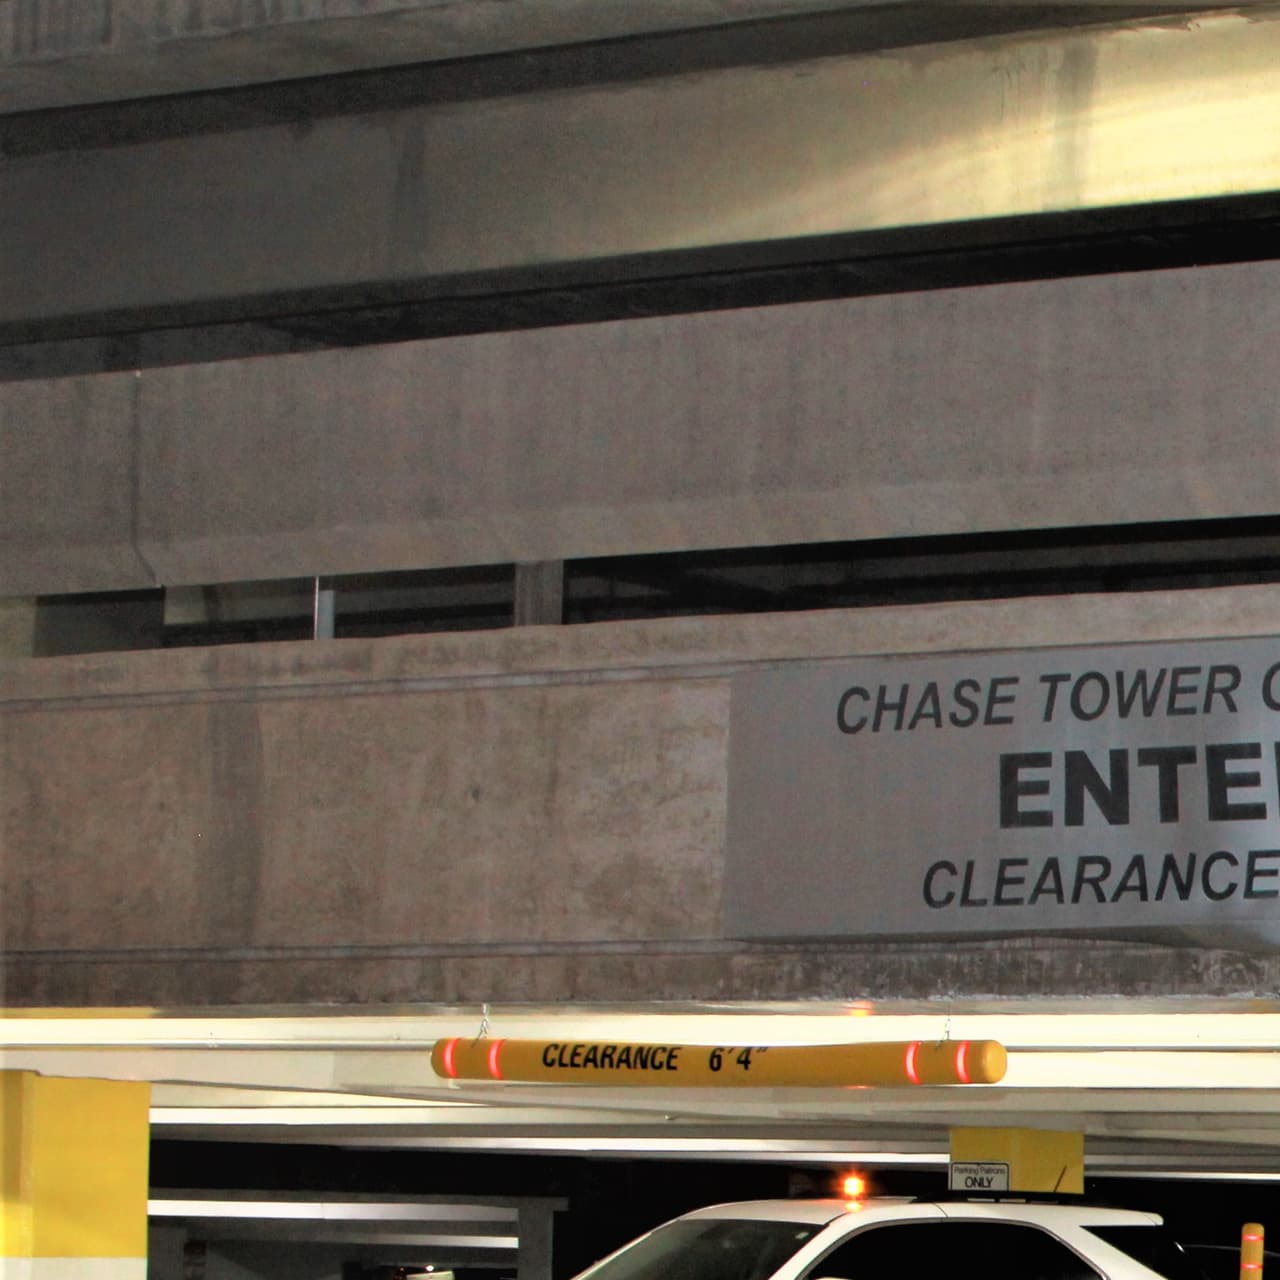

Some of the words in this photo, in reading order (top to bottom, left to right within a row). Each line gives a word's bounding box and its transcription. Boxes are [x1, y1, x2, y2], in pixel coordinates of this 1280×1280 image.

[836, 677, 1019, 735] CHASE
[1040, 664, 1241, 723] TOWER
[922, 849, 1280, 908] CLEARANCE
[542, 1044, 682, 1071] CLEARANCE
[964, 1176, 993, 1188] ONLY
